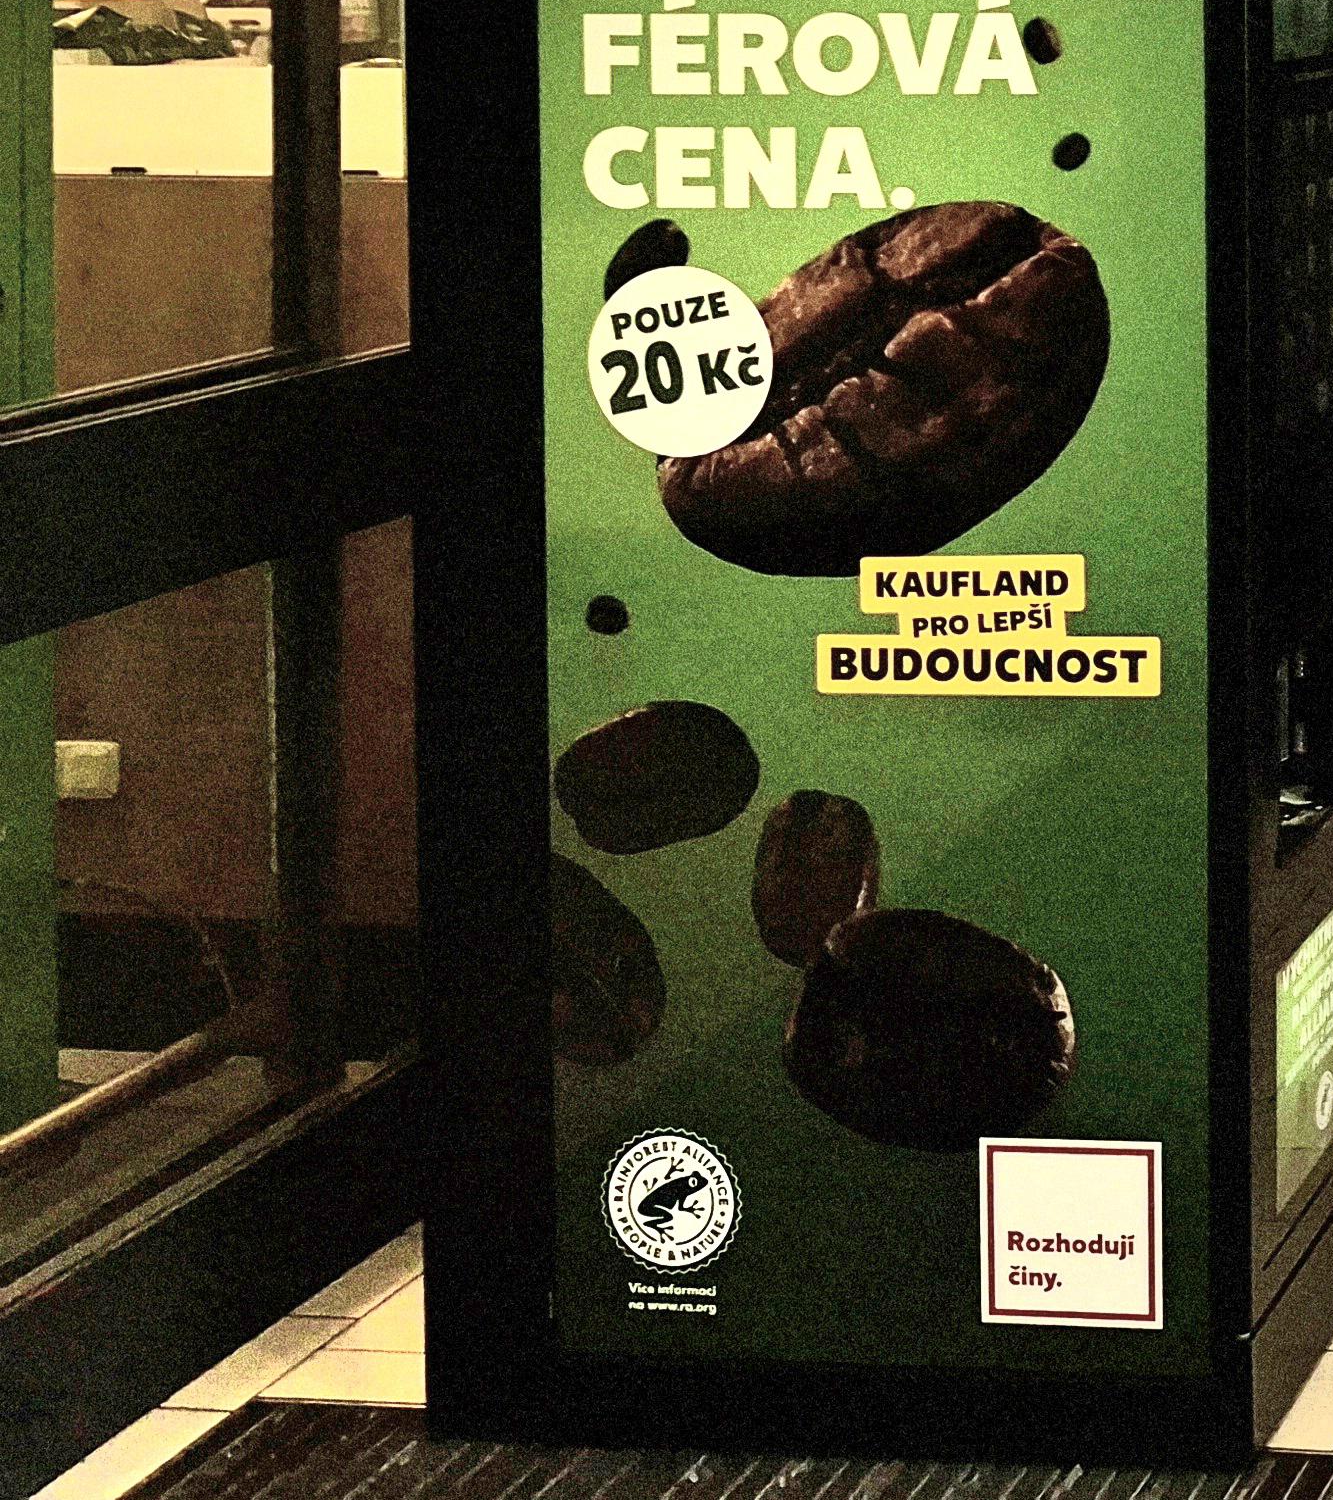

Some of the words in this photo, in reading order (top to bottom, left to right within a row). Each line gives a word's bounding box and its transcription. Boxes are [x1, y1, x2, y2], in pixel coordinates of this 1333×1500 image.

[582, 125, 916, 210] CENA.
[610, 290, 730, 341] POUZE
[601, 340, 684, 415] 20
[697, 342, 765, 396] Kč
[875, 569, 1069, 598] KAUFLAND
[912, 614, 969, 638] PRO
[977, 602, 1053, 633] LEPŠÍ
[830, 647, 1148, 684] BUDOUCNOST
[613, 1141, 677, 1202] RAINFOREST
[682, 1145, 729, 1206] ALLIANCE
[618, 1217, 662, 1259] PEOPLE
[680, 1220, 725, 1260] NATURE
[1007, 1230, 1135, 1261] Rozhodují
[1008, 1265, 1062, 1292] činy.
